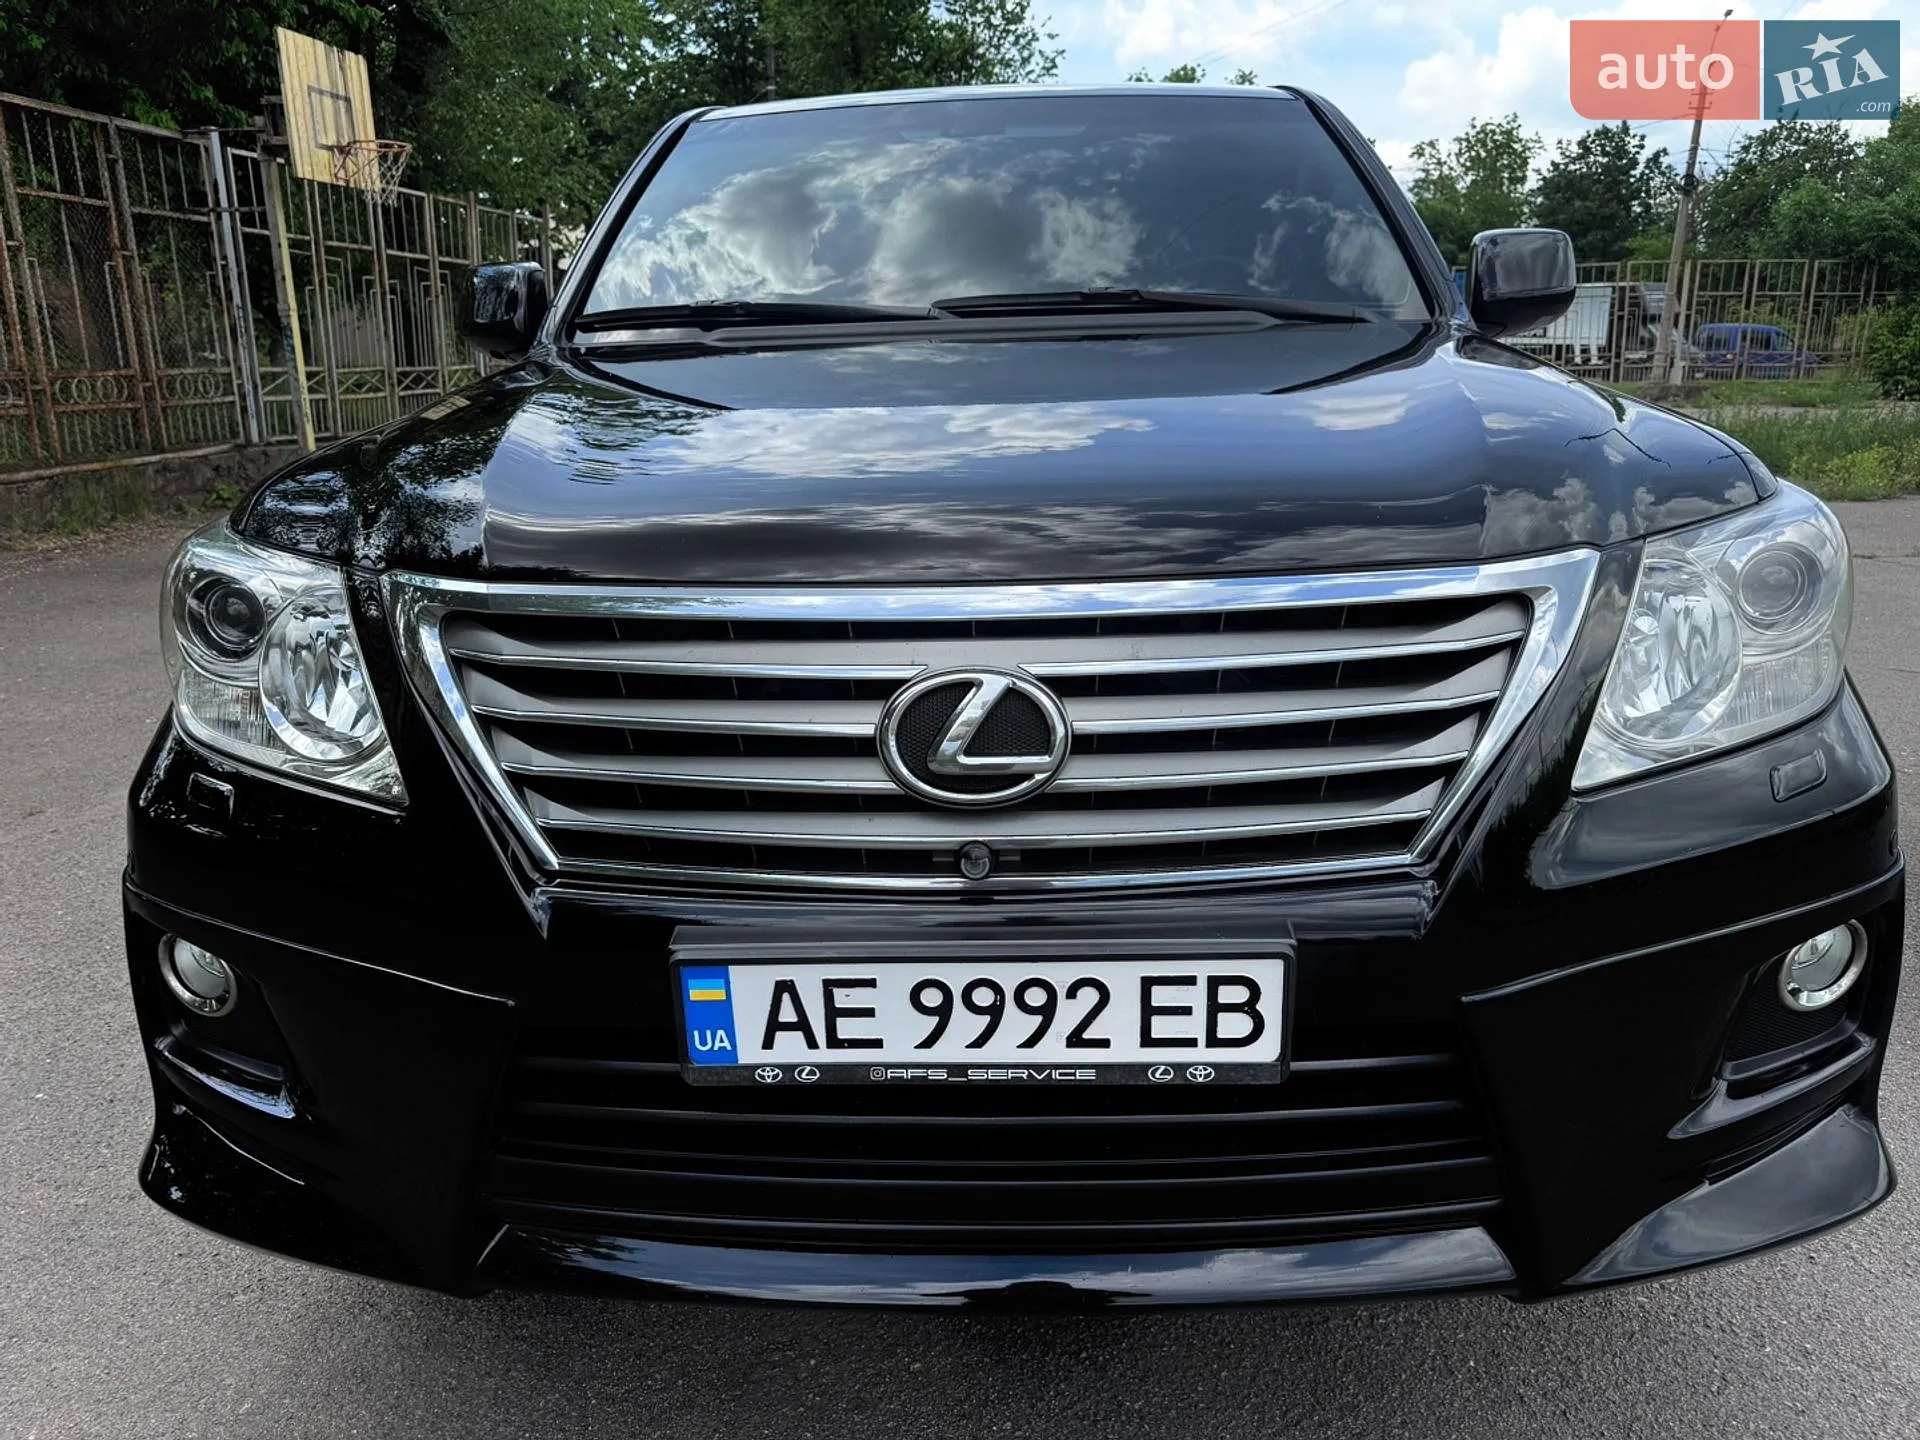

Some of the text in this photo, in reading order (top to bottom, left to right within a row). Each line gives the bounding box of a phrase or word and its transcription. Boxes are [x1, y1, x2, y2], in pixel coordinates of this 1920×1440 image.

[761, 974, 1266, 1050] AE 9992 EB
[692, 1028, 733, 1051] UA
